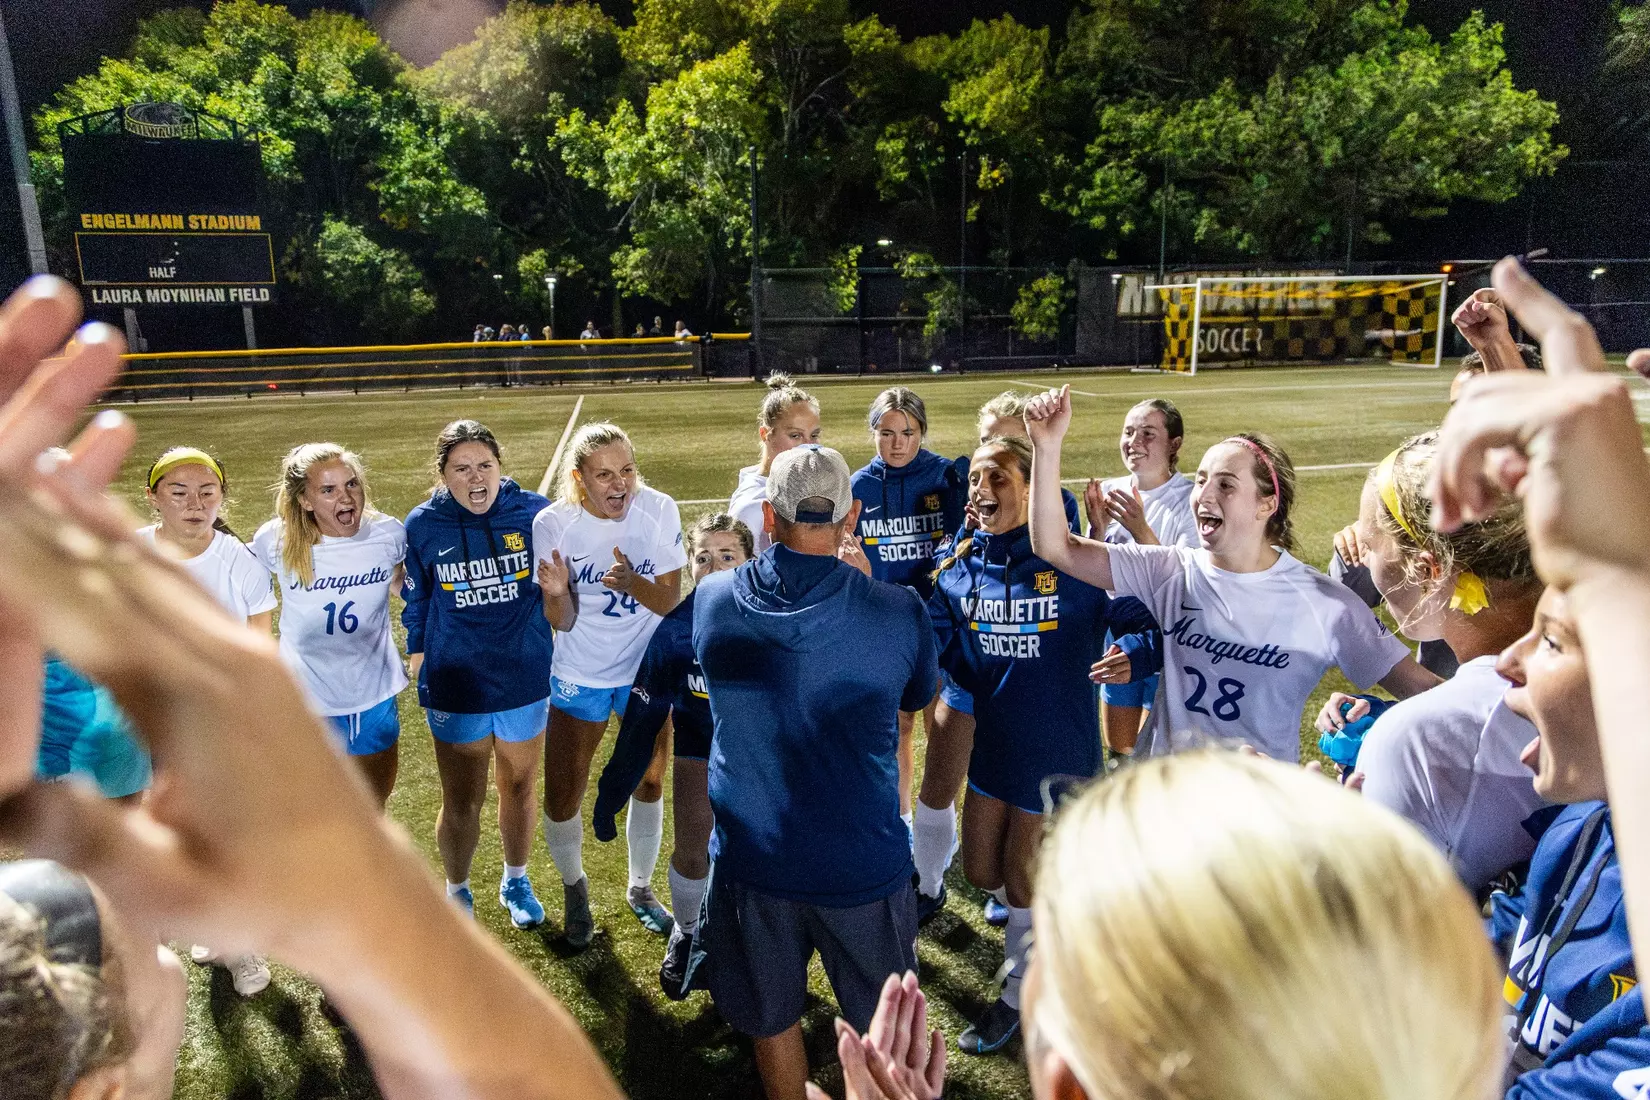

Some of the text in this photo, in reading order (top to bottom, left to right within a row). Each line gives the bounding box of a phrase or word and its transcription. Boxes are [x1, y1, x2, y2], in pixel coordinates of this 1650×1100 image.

[81, 214, 261, 230] ENGELMANN STADIUM
[149, 267, 176, 278] HALF
[92, 288, 270, 303] LAURA MOYNIHAN FIELD
[861, 512, 943, 537] MARQUETTE
[878, 541, 934, 562] SOCCER
[573, 559, 656, 584] Maette
[1034, 571, 1058, 594] MU
[455, 582, 519, 609] SOCCER
[602, 591, 640, 617] 24
[323, 600, 359, 635] 16
[960, 595, 1059, 623] MARQUETTE
[978, 633, 1041, 658] SOCCER
[1163, 615, 1290, 669] Marquette
[1183, 665, 1246, 721] 28
